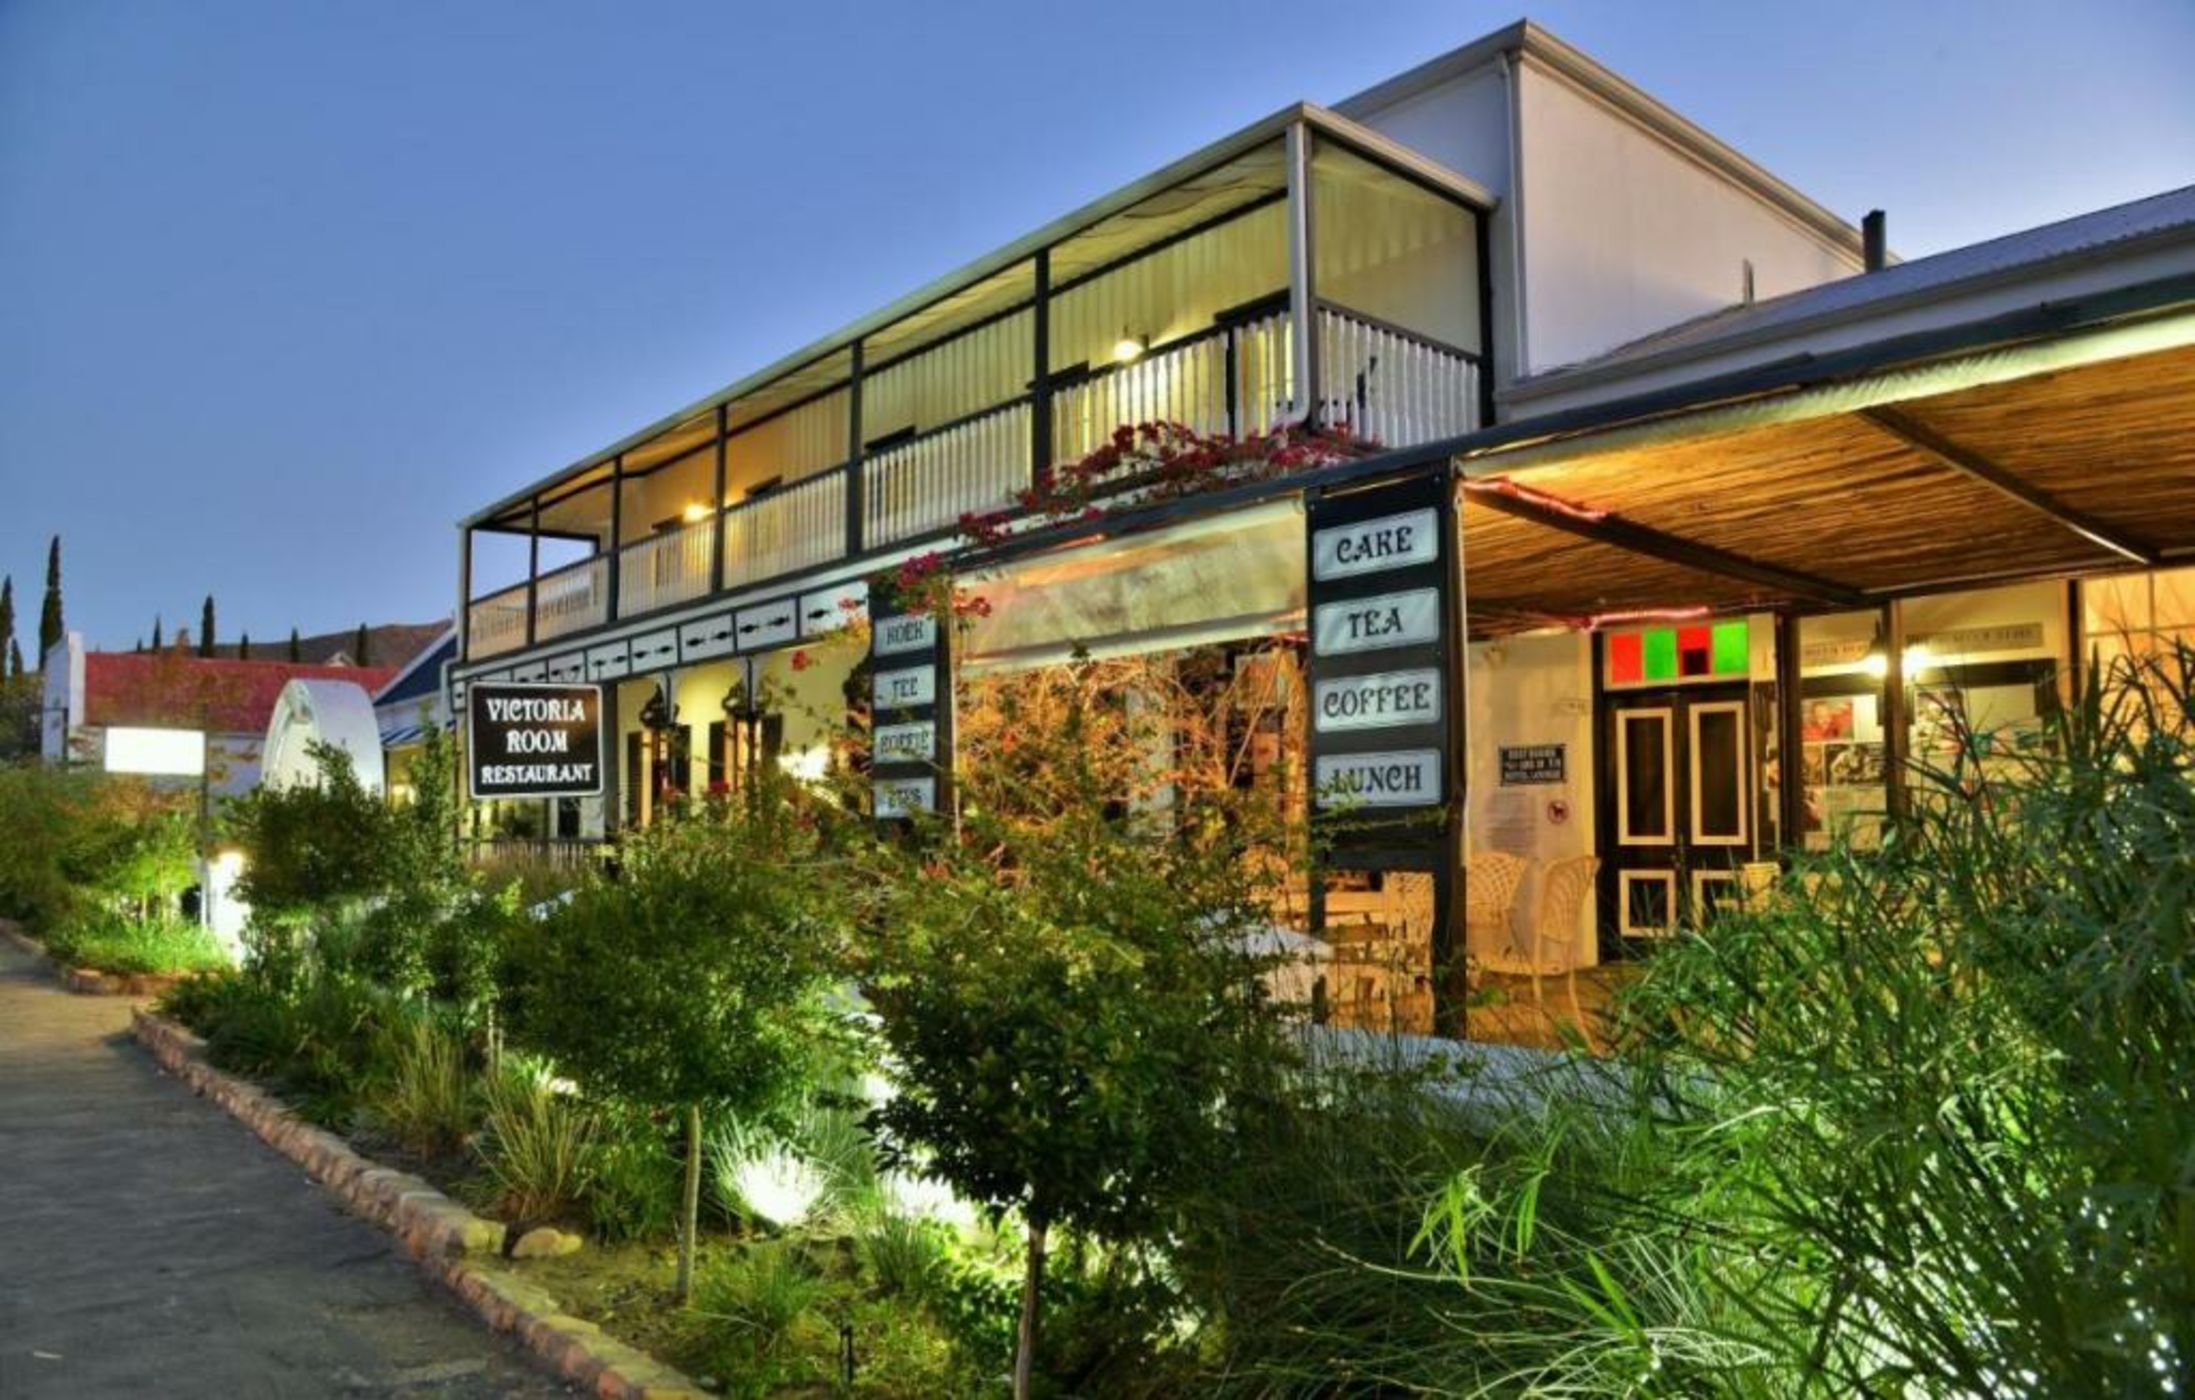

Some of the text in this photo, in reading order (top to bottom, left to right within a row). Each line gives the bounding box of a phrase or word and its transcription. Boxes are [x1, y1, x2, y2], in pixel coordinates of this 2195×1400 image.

[1336, 526, 1413, 564] CAKE
[1348, 608, 1403, 638] TEA
[892, 677, 919, 698] TEE
[1323, 682, 1431, 718] COFFEE
[486, 698, 586, 721] VICTORIA
[506, 729, 568, 753] ROOM
[481, 764, 592, 784] RESTAURANT
[1333, 764, 1422, 794] LUNCH
